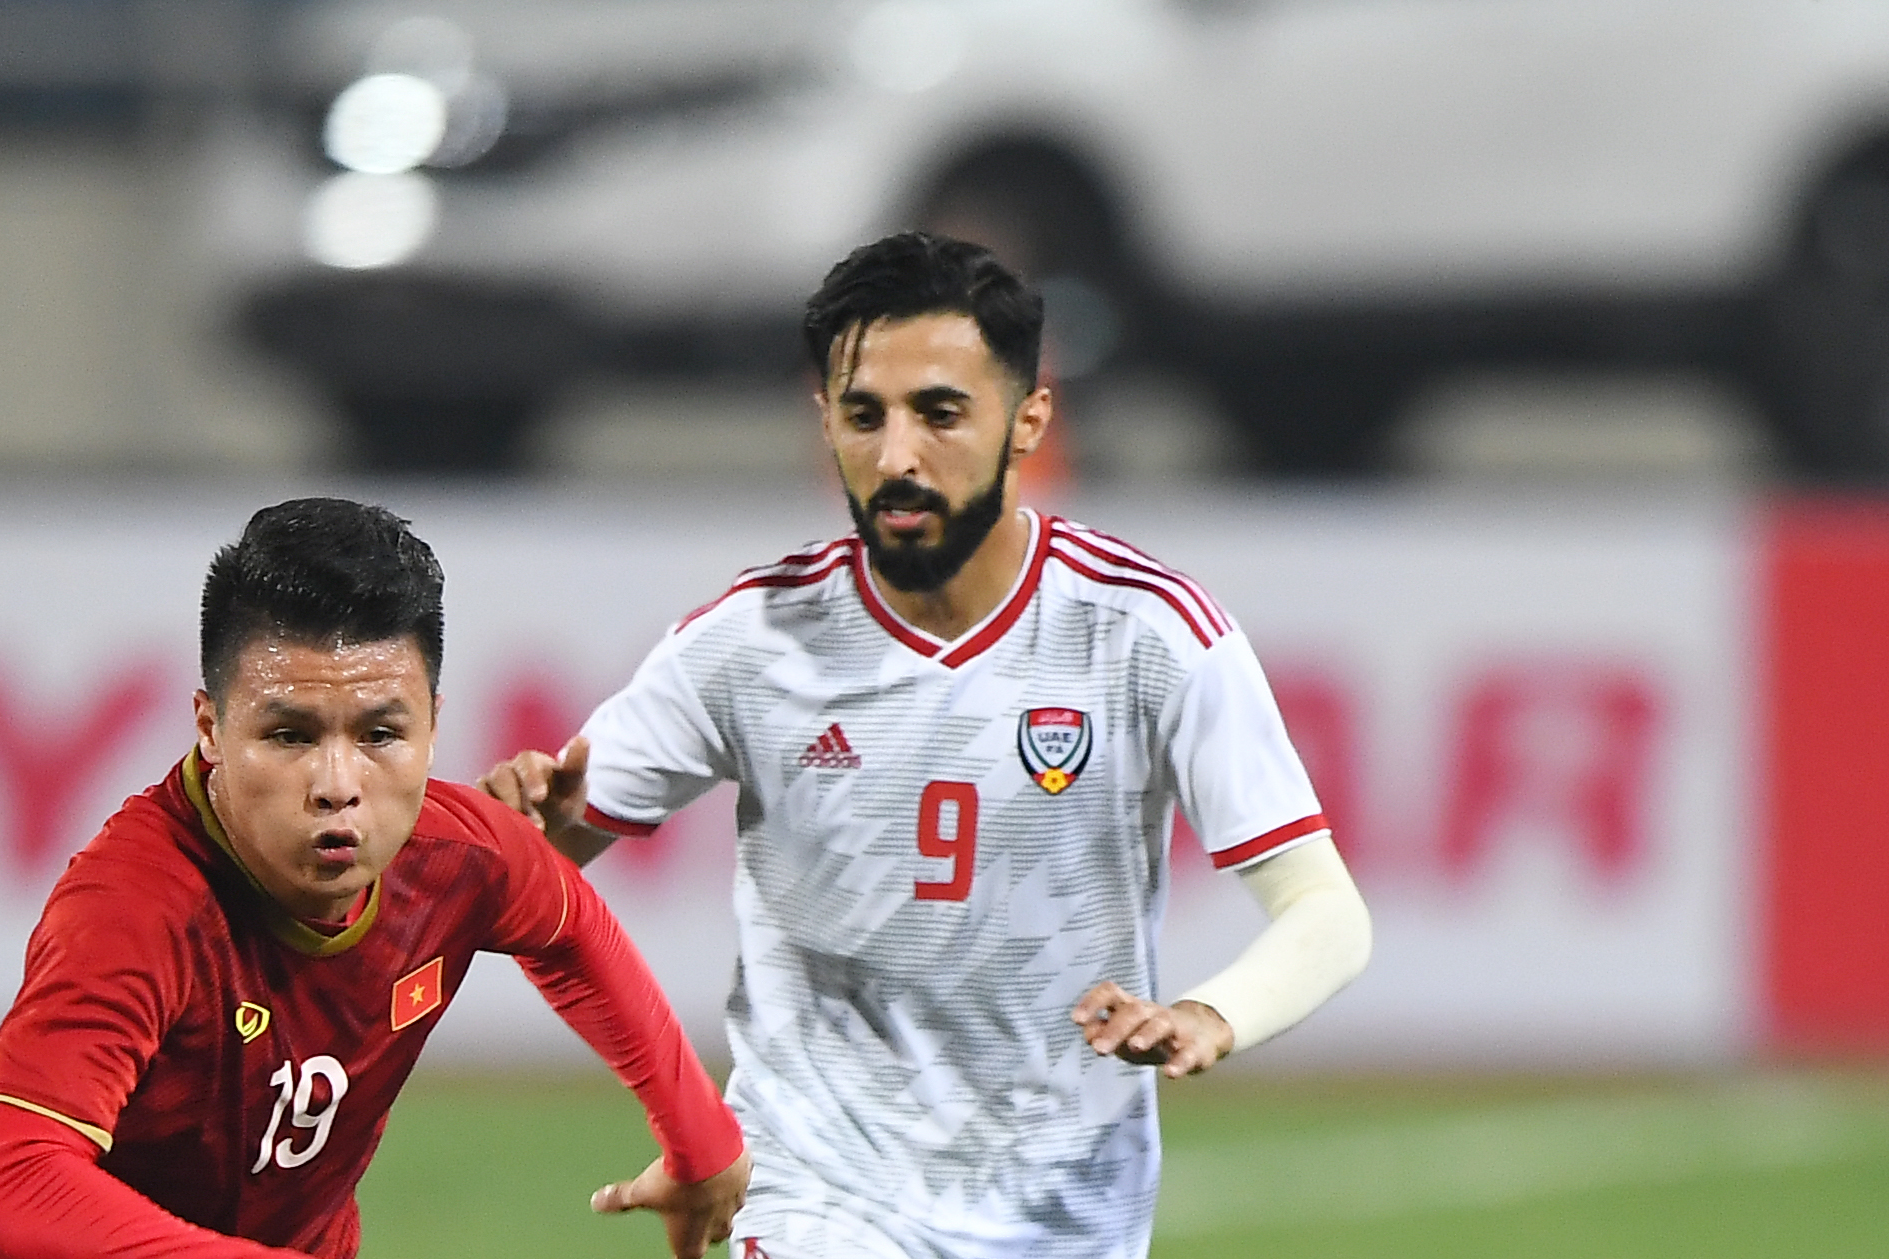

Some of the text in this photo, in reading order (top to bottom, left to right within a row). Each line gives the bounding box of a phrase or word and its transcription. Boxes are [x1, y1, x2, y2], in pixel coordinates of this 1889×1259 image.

[1037, 731, 1073, 743] UAE
[914, 779, 980, 902] 9
[250, 1054, 349, 1175] 19
